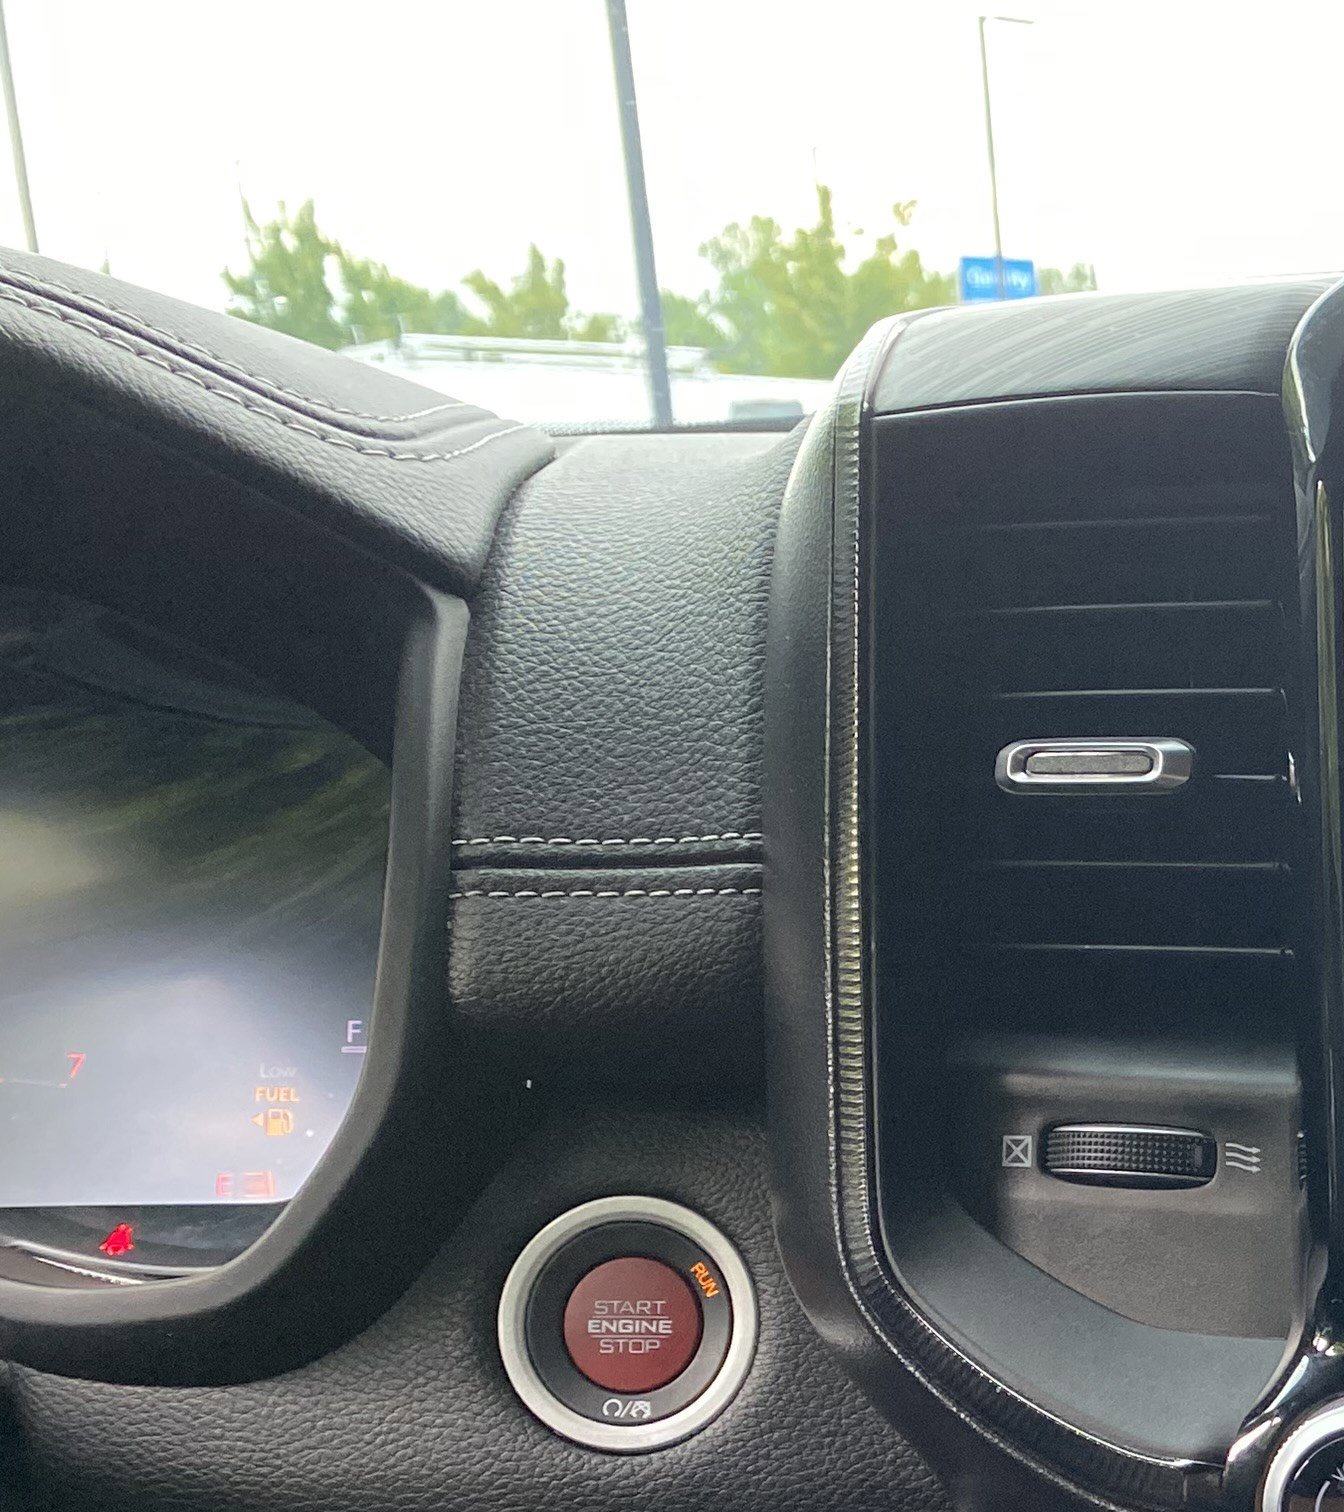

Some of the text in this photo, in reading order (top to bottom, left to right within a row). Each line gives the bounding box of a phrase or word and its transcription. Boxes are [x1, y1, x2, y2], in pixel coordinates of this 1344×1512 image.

[63, 1050, 88, 1081] 7
[254, 1085, 302, 1104] FUEL
[689, 1261, 720, 1299] RUN
[593, 1299, 667, 1315] START
[587, 1319, 673, 1334] ENGINE
[598, 1338, 661, 1354] STOP
